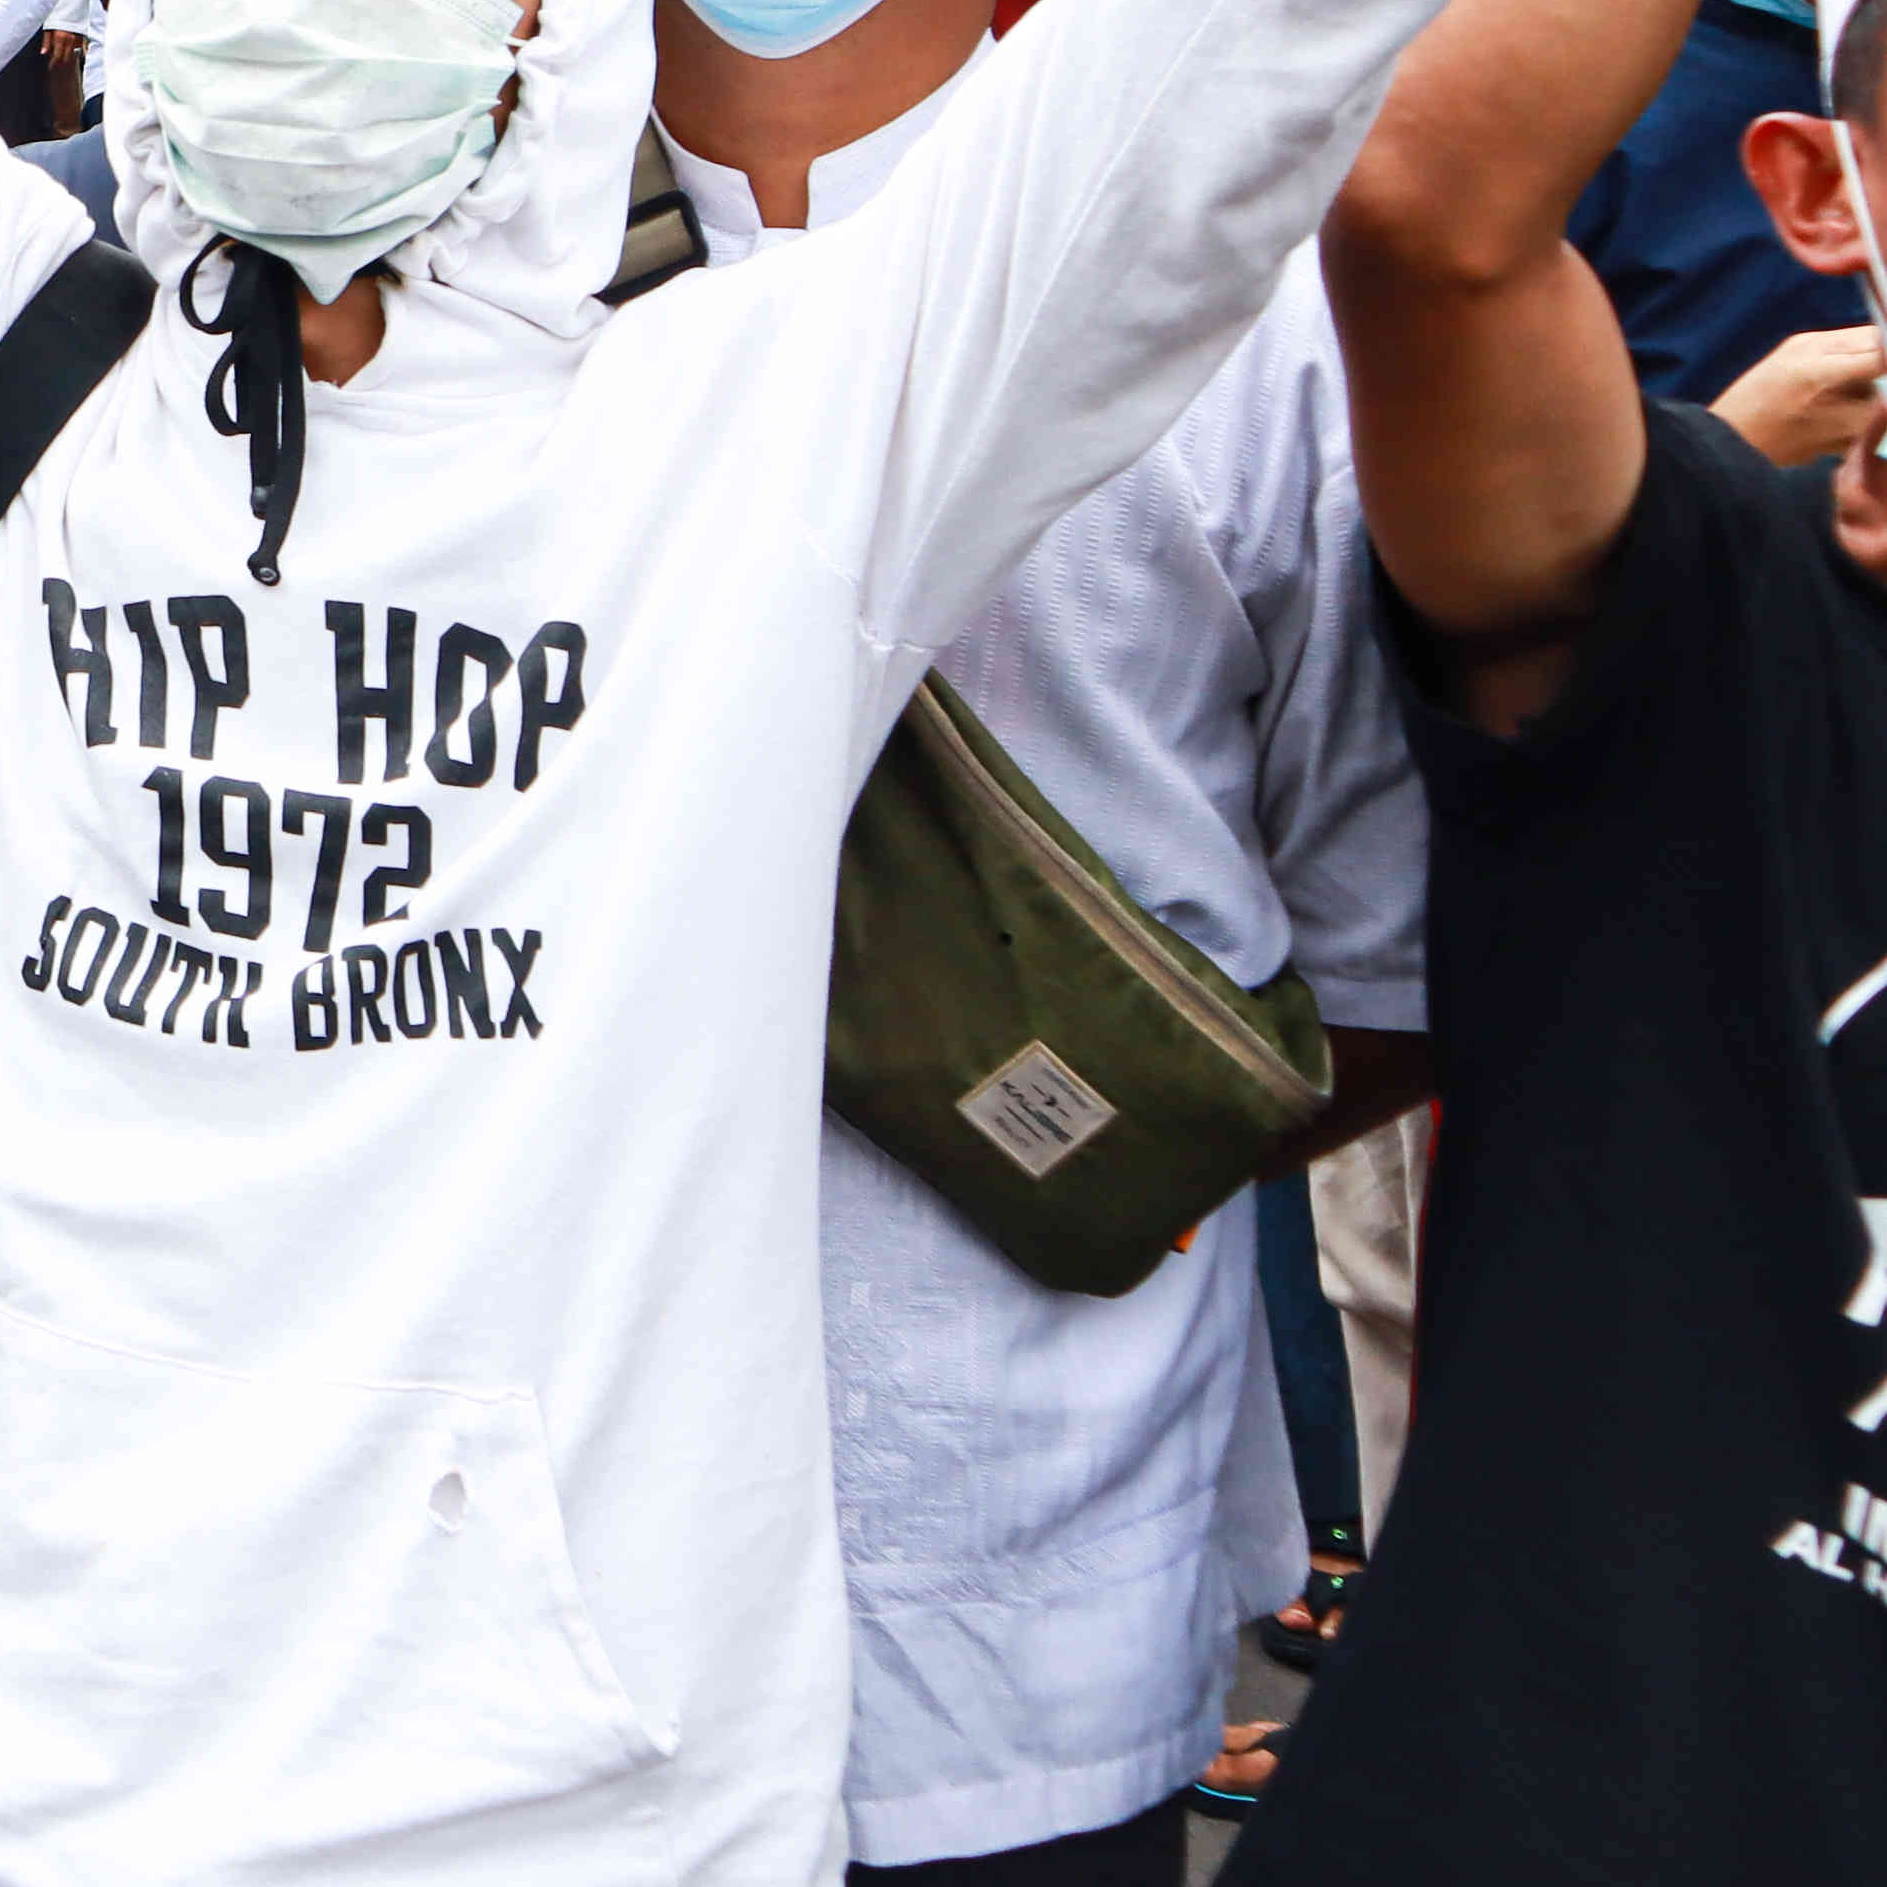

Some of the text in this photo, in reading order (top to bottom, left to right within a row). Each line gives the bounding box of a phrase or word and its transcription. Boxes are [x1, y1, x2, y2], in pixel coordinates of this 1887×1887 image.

[41, 576, 588, 793] HIP HOP
[140, 765, 432, 954] 1972
[20, 894, 544, 1053] SOUTH BRONX
